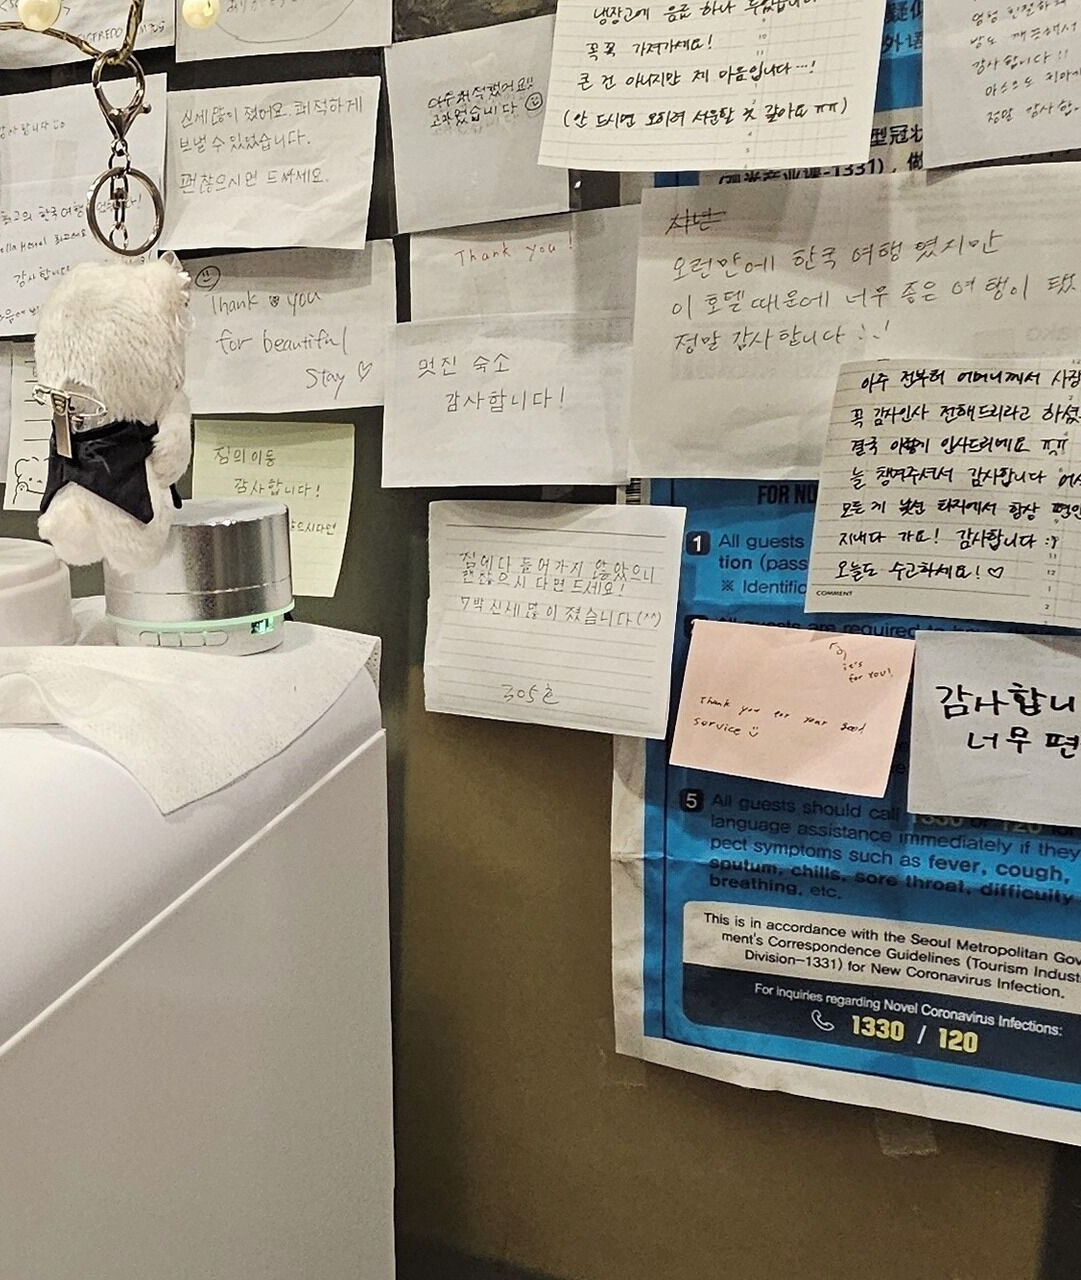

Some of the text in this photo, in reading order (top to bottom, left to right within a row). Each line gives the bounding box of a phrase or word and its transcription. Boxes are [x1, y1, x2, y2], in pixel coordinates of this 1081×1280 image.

[593, 0, 736, 25] 냉장고에 하나
[578, 71, 594, 91] 큰
[601, 71, 617, 89] 건
[691, 69, 709, 84] 제
[645, 108, 686, 128] 오히려
[212, 133, 225, 151] 수
[454, 242, 511, 267] Thank
[792, 240, 902, 270] 한국 여행
[211, 290, 322, 316] Thank you
[672, 294, 692, 319] 이
[705, 290, 745, 315] 호텔
[845, 288, 890, 309] 너무
[216, 328, 252, 355] for
[418, 352, 510, 379] 멋진 숙소
[861, 373, 889, 393] 아주
[956, 371, 1041, 386] 어머니께서
[446, 386, 566, 413] 감사합니다!
[234, 478, 321, 498] 감사합니다!
[850, 467, 1047, 489] 늘 감사합니다
[757, 485, 789, 505] FOR
[1008, 502, 1040, 521] 항상
[693, 535, 701, 552] 1
[718, 534, 805, 551] All guests
[898, 528, 940, 544] 가요!
[956, 529, 1037, 551] 감사합니다
[719, 553, 809, 571] tion (pass
[835, 561, 981, 581] 오늘도 수고하세요!
[967, 726, 1032, 754] 너무
[685, 793, 698, 809] 5
[711, 794, 900, 822] All guests should call
[710, 814, 791, 834] language
[797, 823, 892, 842] assistance
[899, 831, 1012, 855] immediately
[1020, 842, 1030, 854] if
[1039, 842, 1081, 863] they
[710, 837, 1070, 884] pect symptoms such as fever, cough,
[810, 885, 841, 900] etc.
[854, 873, 1073, 906] sore throat, difficulty
[704, 912, 1048, 961] This is in accordance with the Seoul Metropolitan
[722, 931, 1028, 975] ment's Correspondence Guidelines (Tourism
[848, 961, 1065, 999] for New Coronavirus Infection.
[755, 983, 1063, 1037] For regarding Novel Coronavirus Infections:
[851, 1015, 978, 1053] 1330 120
